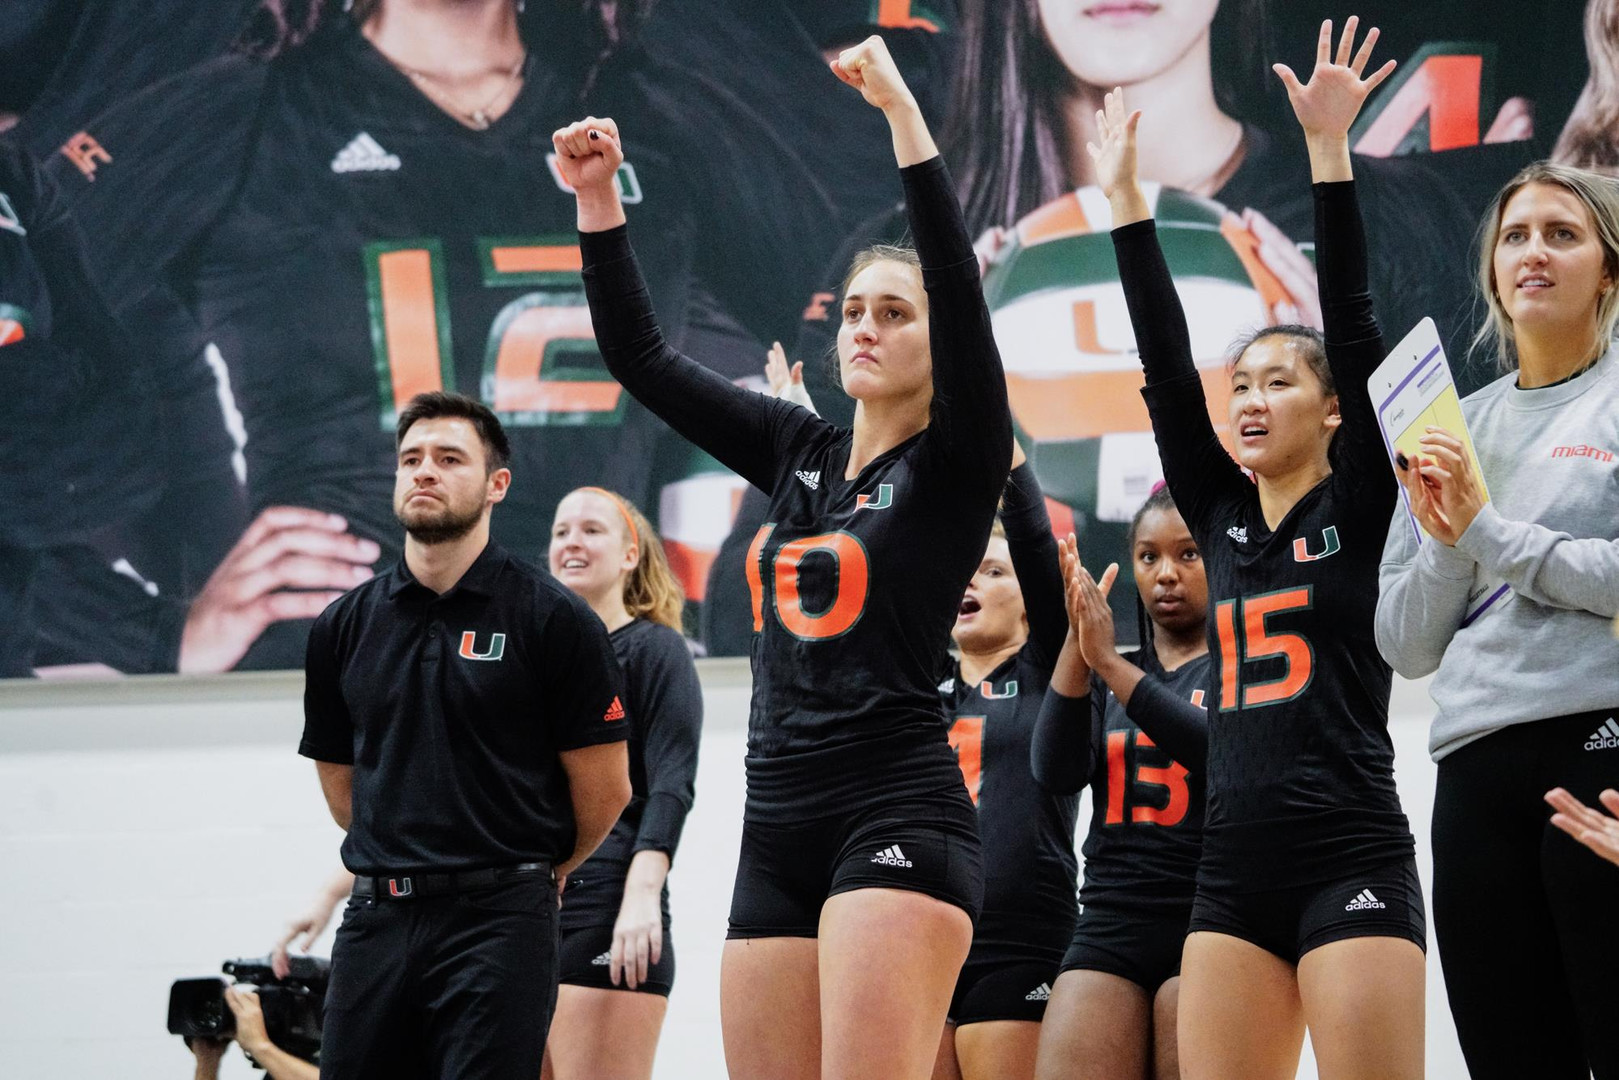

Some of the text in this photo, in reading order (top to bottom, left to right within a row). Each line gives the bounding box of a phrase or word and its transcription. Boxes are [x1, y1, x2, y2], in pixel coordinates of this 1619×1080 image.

[364, 236, 628, 430] 12
[1293, 525, 1341, 563] U
[745, 522, 871, 642] 10
[459, 631, 506, 661] U
[1215, 584, 1316, 713] 15
[981, 680, 1018, 700] U
[1583, 737, 1619, 751] adid
[1104, 729, 1192, 827] 13
[389, 877, 412, 896] U
[1345, 901, 1386, 911] adidas
